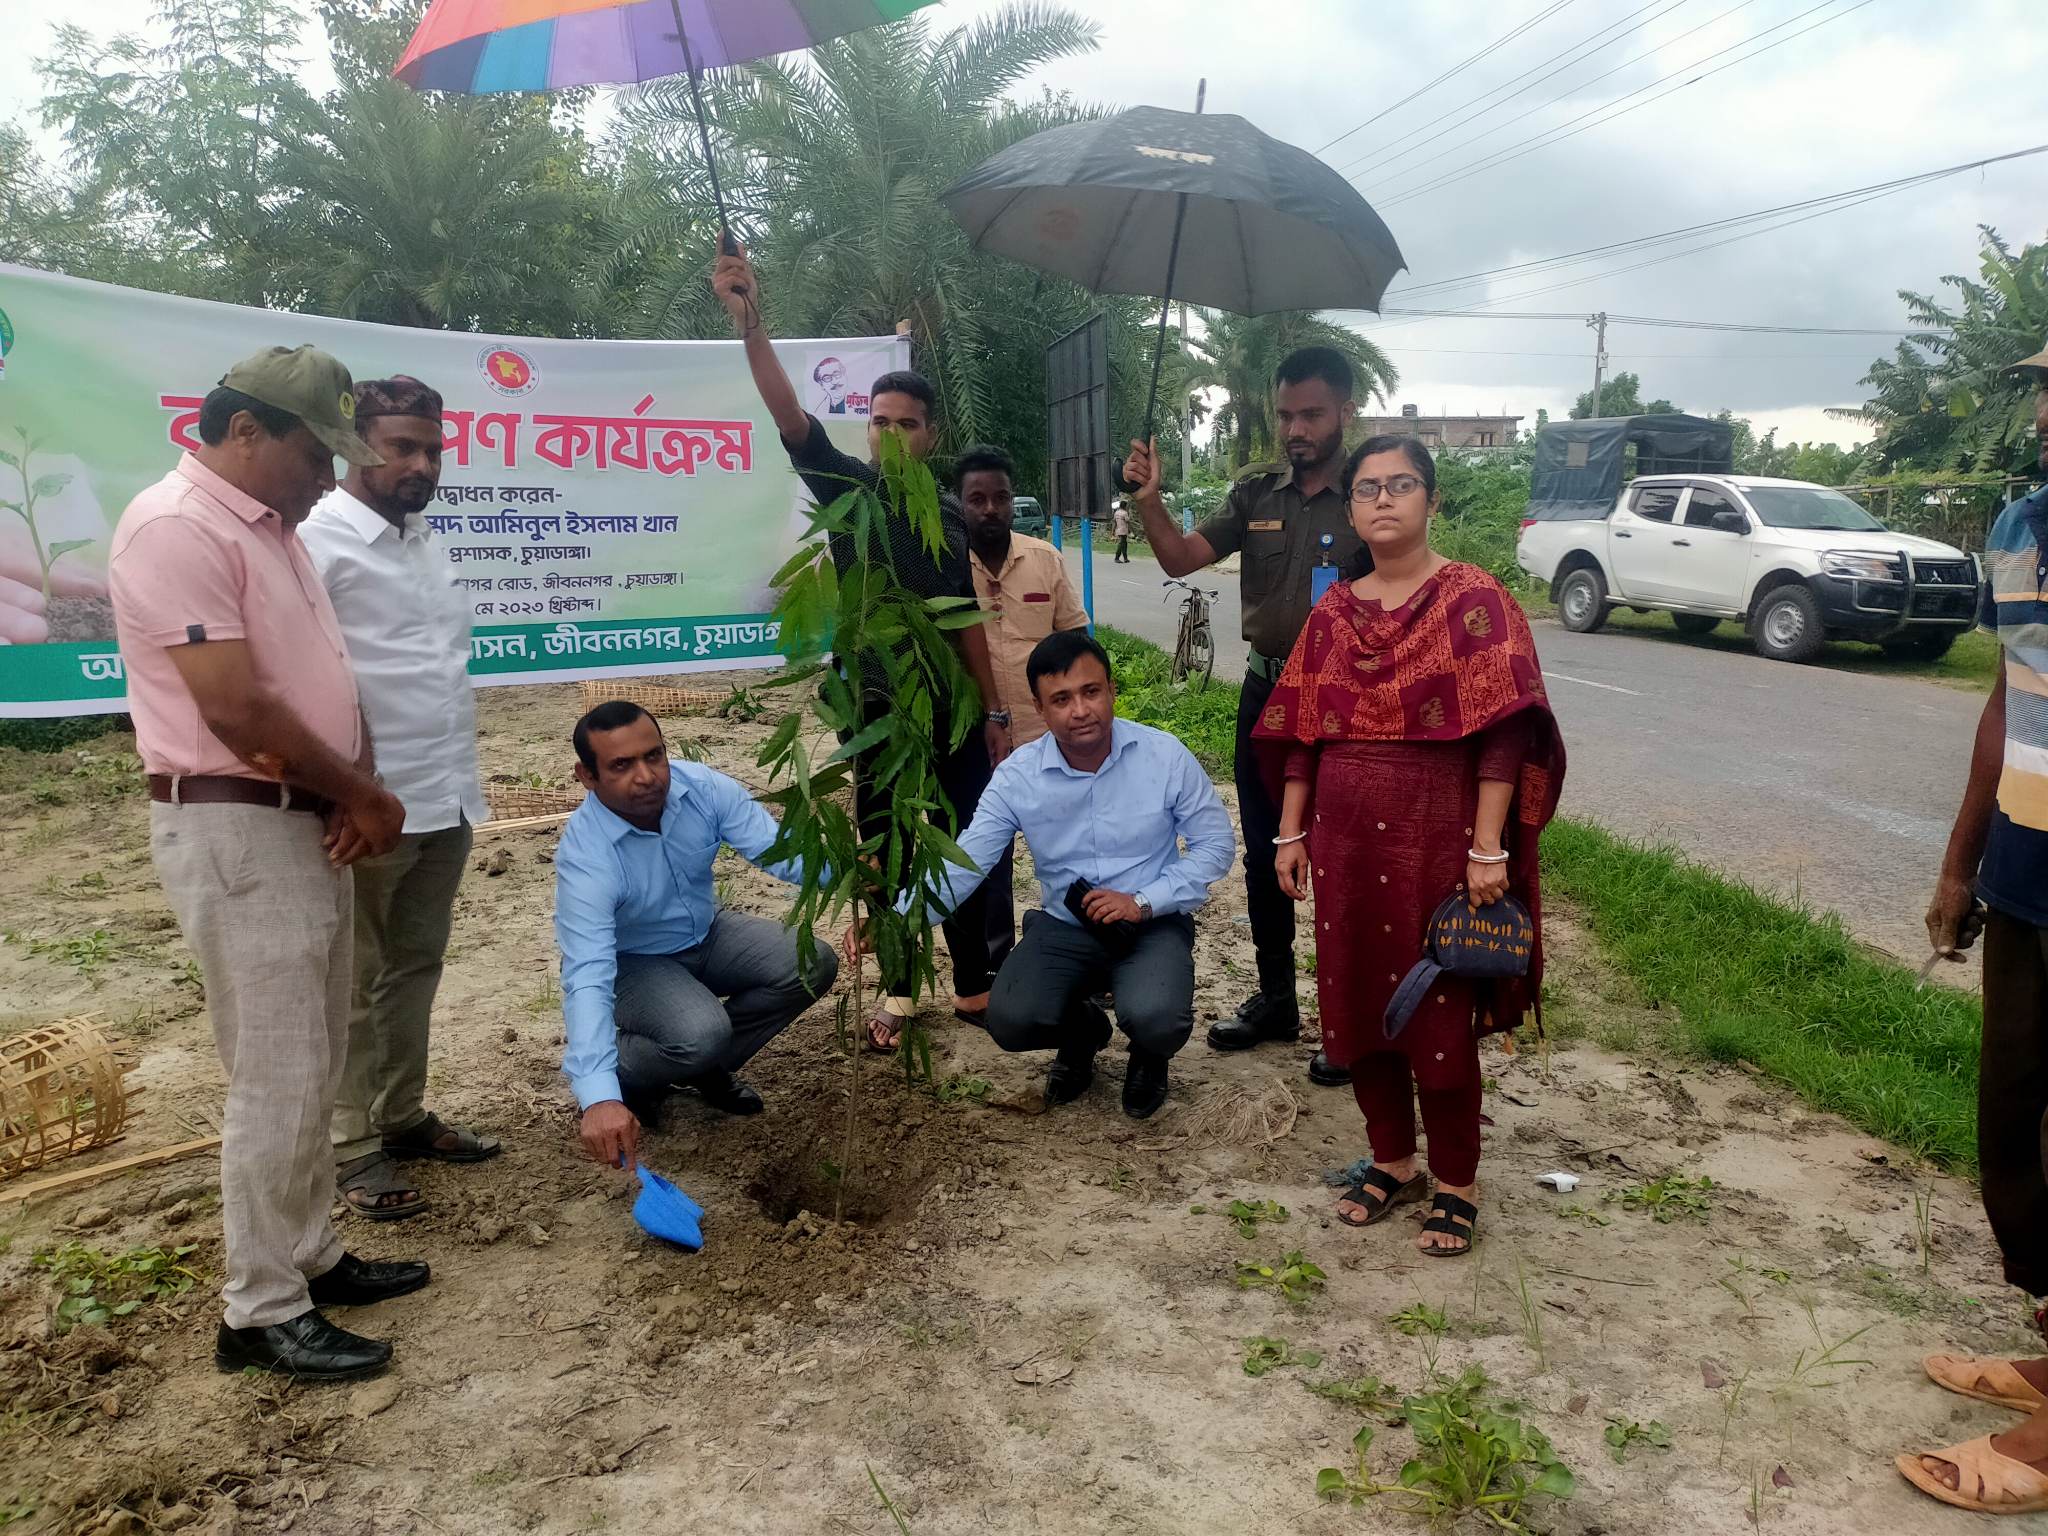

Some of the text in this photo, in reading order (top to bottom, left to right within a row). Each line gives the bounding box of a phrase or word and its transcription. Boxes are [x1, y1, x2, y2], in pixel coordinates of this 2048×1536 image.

[441, 393, 753, 476] পণ কার্যক্রম
[430, 486, 563, 506] দ্বোধন করেন-
[467, 509, 561, 541] আমিনুল
[565, 511, 638, 535] ইসলাম
[643, 515, 679, 533] খান
[449, 546, 518, 563] প্রশাসক,
[520, 546, 591, 566] চুয়াডাঙ্গা।
[497, 577, 538, 592] রোড,
[475, 602, 494, 615] মে
[499, 602, 544, 616] ২০২৩
[542, 623, 689, 655] জীবননগর,
[693, 621, 782, 656] চুয়াডাঙ্গ
